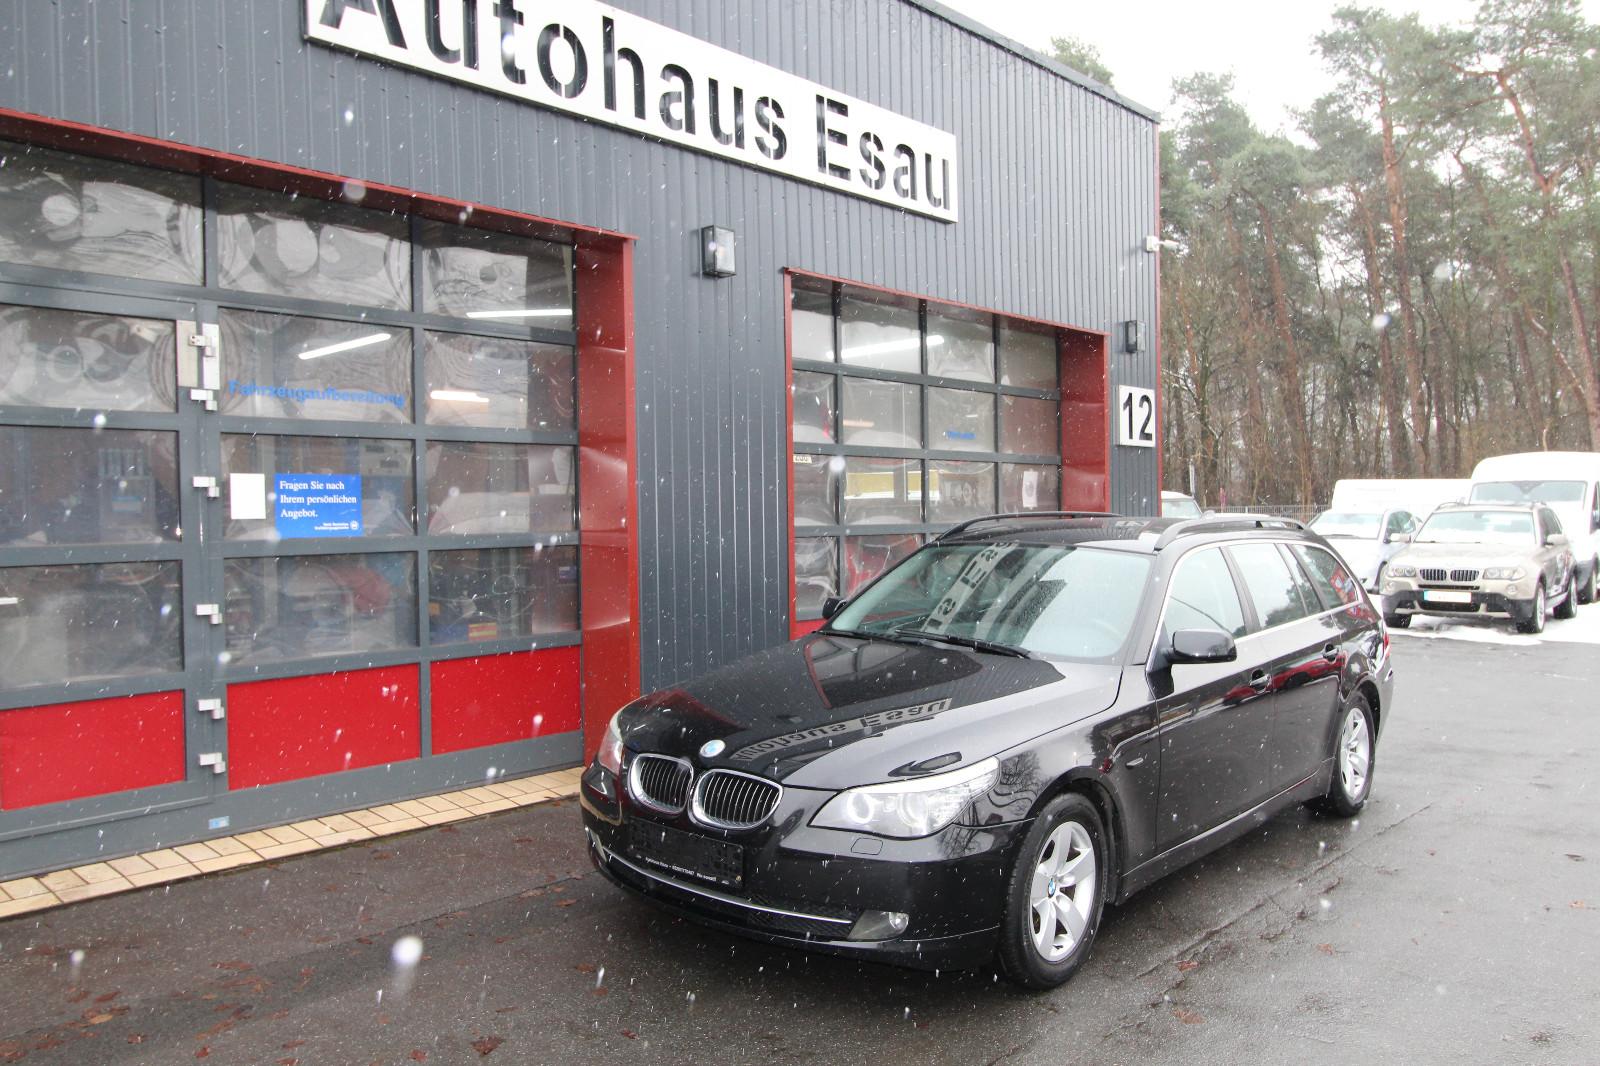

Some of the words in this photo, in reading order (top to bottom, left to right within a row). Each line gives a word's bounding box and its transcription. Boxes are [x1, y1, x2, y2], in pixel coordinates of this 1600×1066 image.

[815, 94, 951, 211] Esau
[1122, 392, 1153, 441] 12
[280, 480, 308, 491] Fragen
[310, 480, 323, 490] Sie
[326, 480, 345, 490] nach
[280, 494, 305, 504] Ihrem
[306, 494, 357, 505] persönlichen
[280, 508, 318, 519] Angebot.
